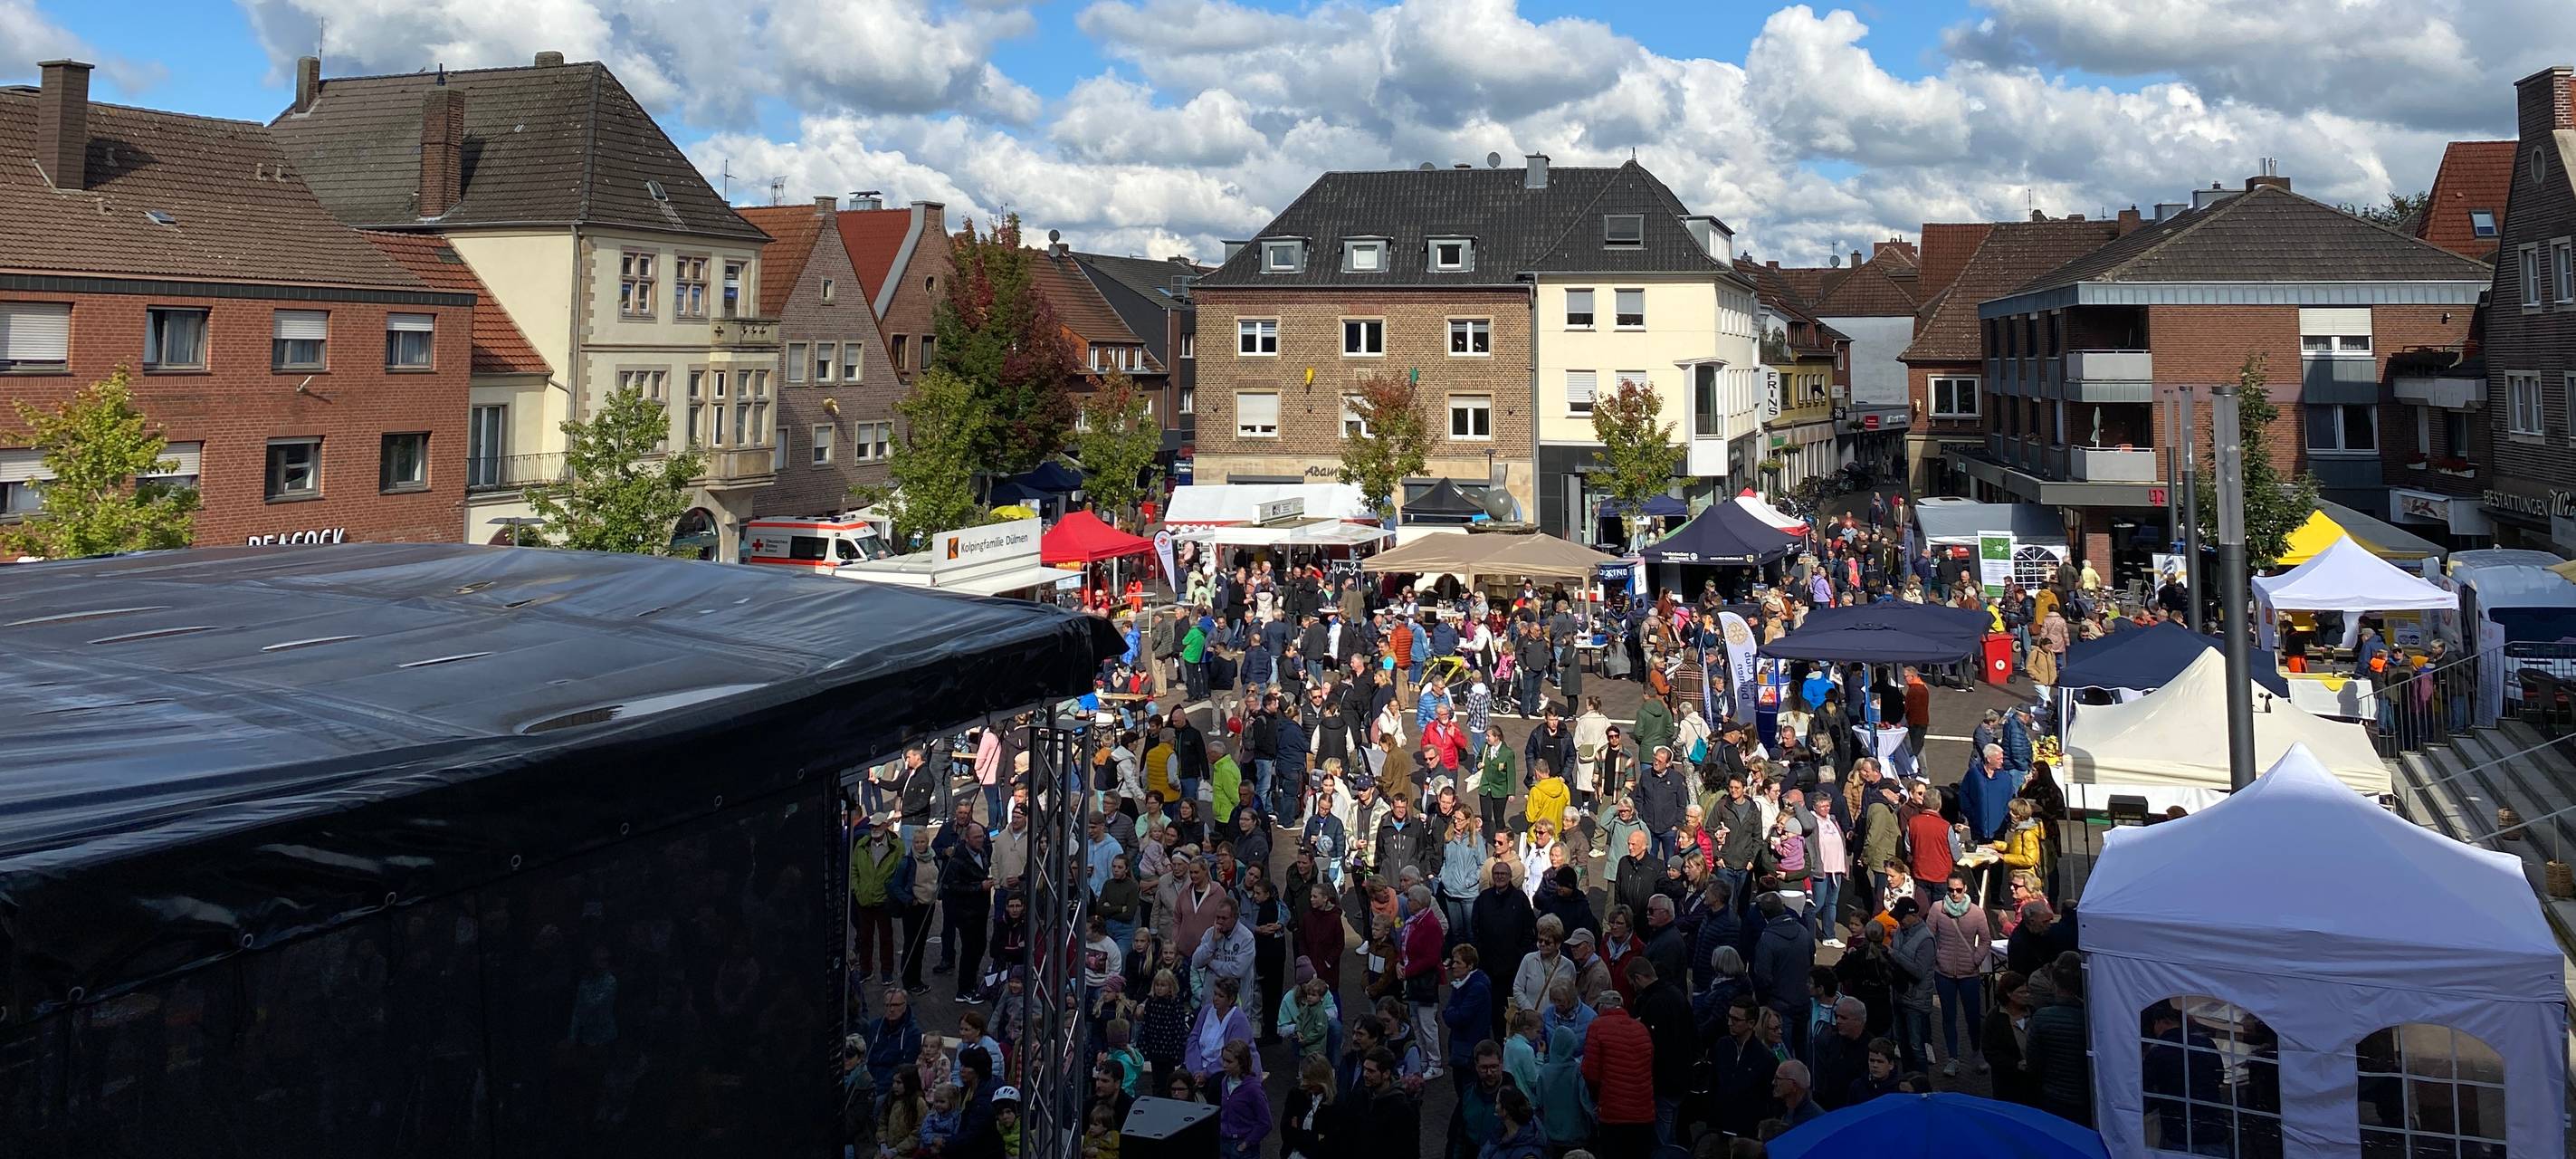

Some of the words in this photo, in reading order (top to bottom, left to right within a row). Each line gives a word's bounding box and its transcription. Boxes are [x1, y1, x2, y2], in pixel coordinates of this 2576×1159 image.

[1767, 372, 1778, 416] FRINS
[2484, 490, 2549, 517] BESTATTUNGEN
[961, 537, 1004, 554] Kolpingfamilie
[1006, 534, 1028, 546] Dülmen
